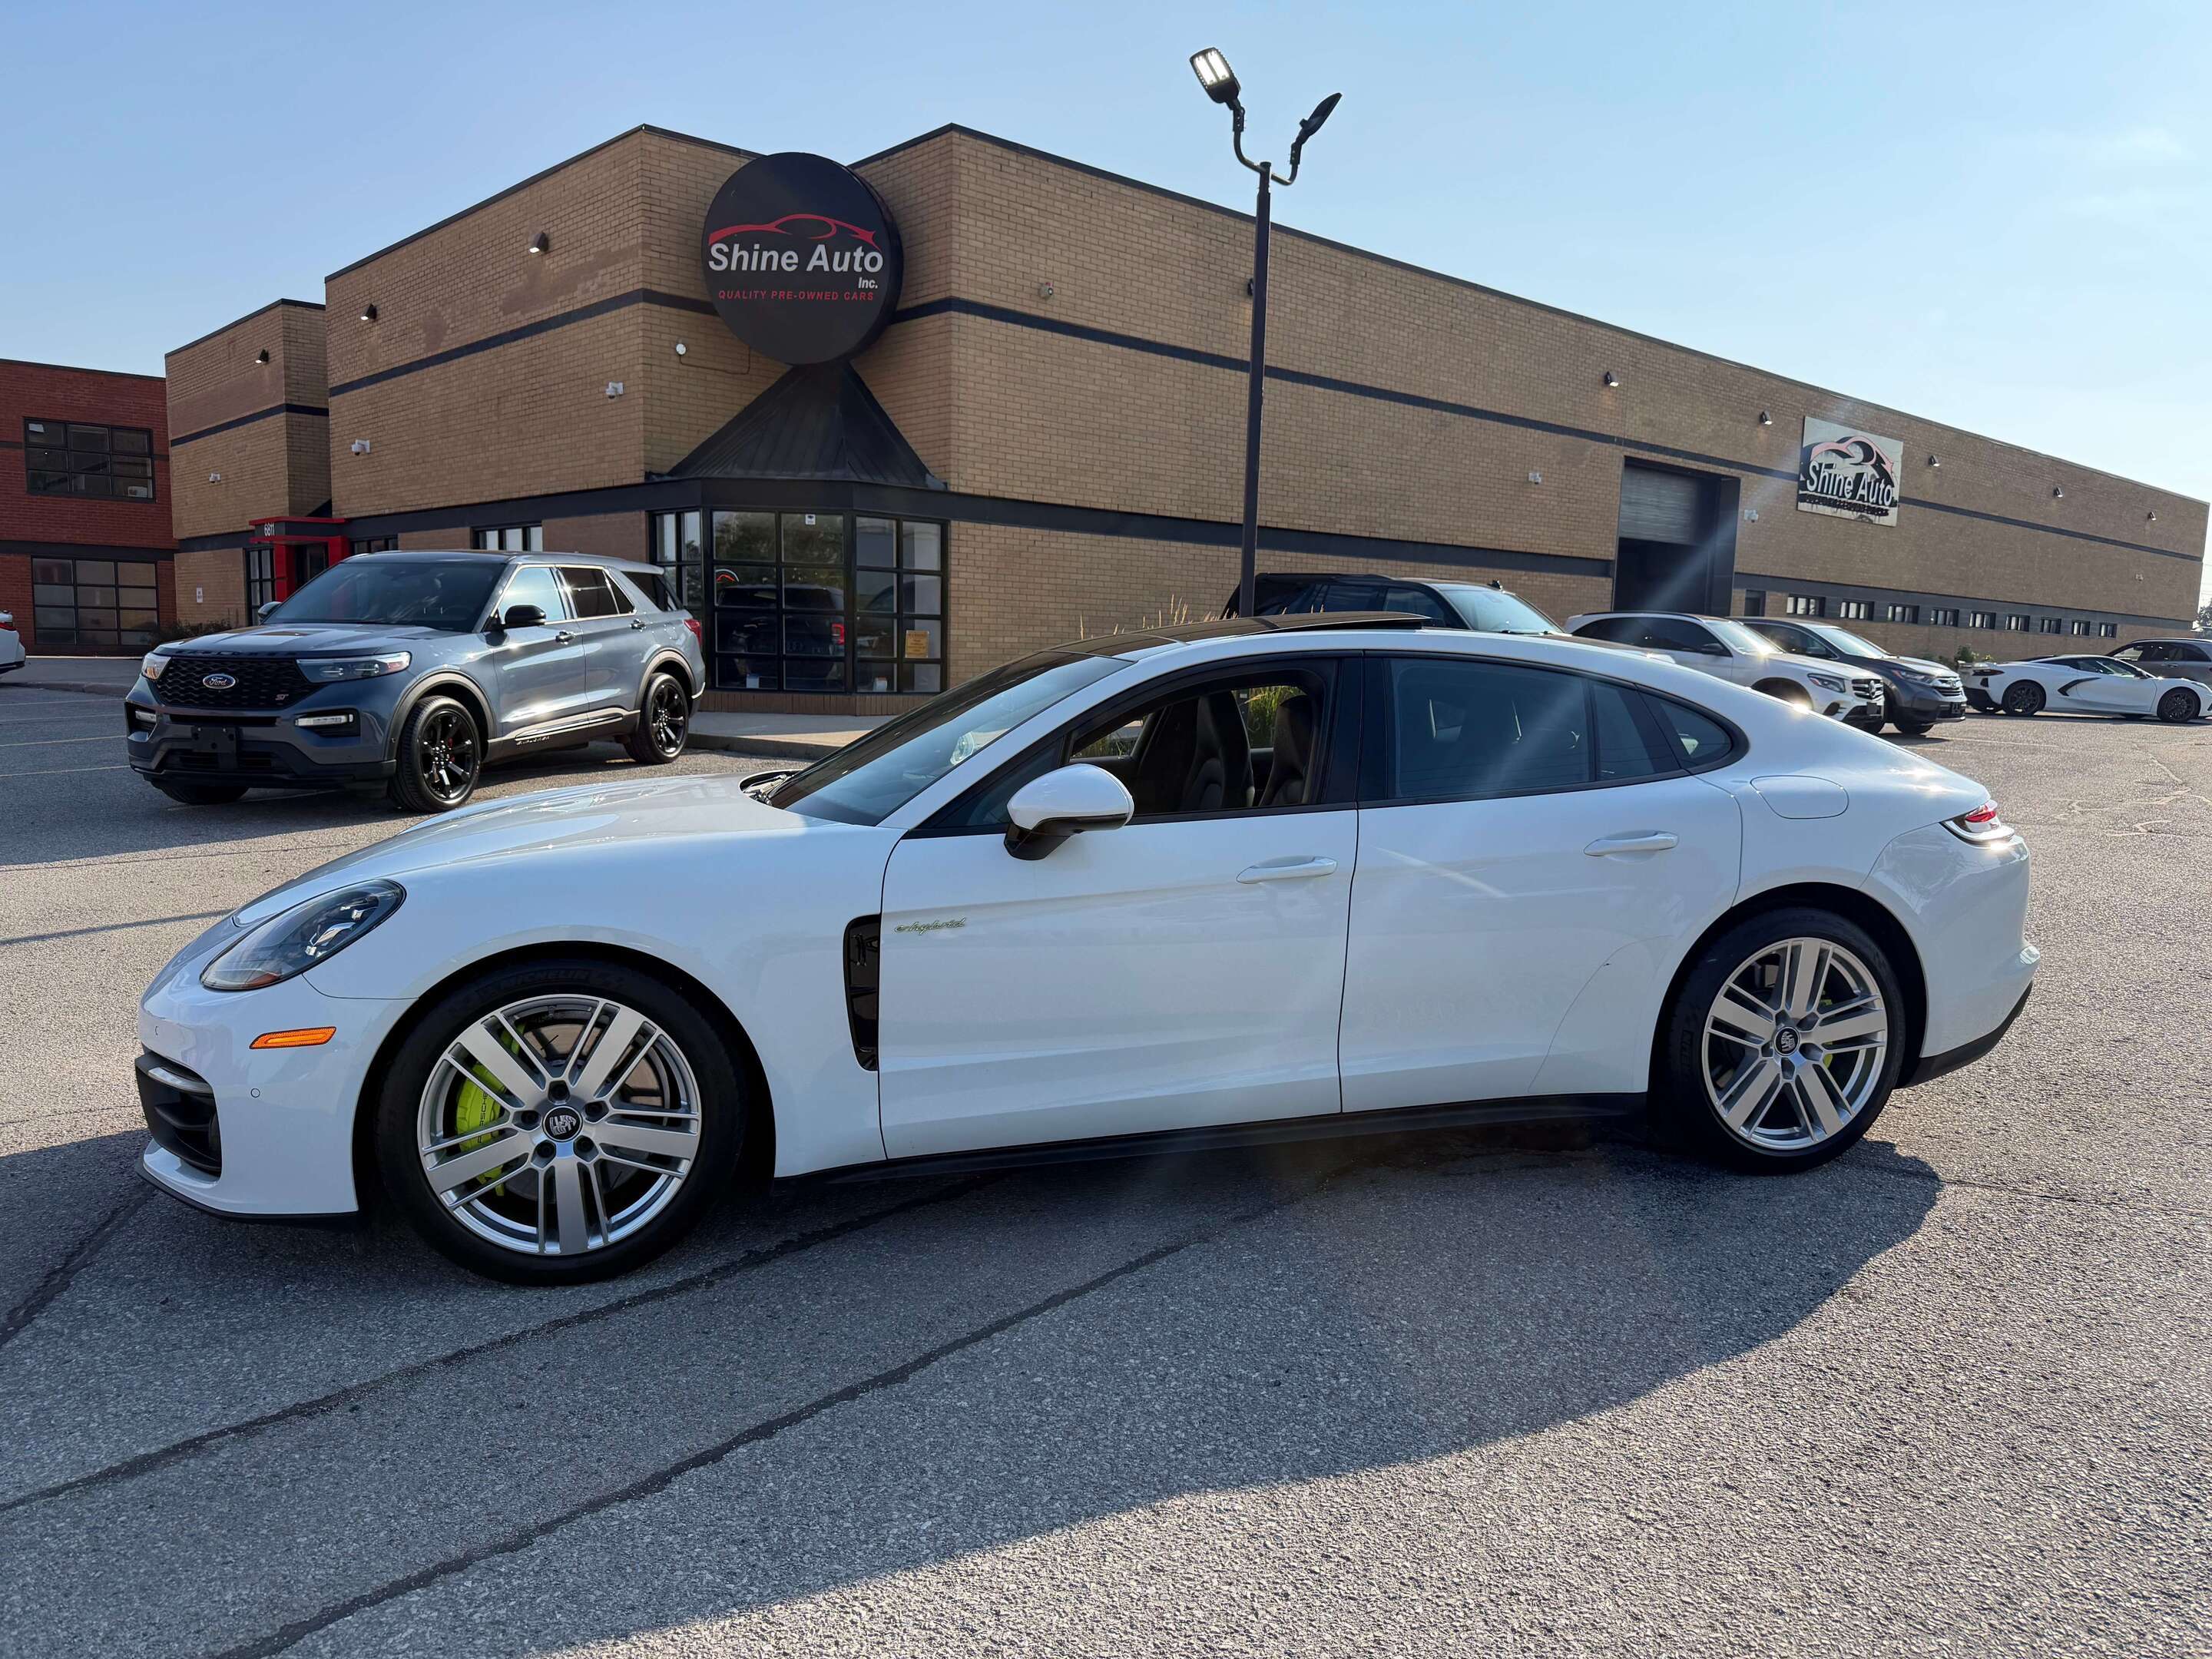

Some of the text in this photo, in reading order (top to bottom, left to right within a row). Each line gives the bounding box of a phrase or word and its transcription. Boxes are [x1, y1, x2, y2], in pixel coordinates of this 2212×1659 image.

[709, 243, 883, 273] Shine Auto
[858, 277, 878, 289] Inc.
[718, 290, 874, 301] QUALITY PRE-OWNED CARS
[1806, 461, 1853, 499] Shine
[1856, 472, 1893, 506] Auto
[264, 522, 275, 536] 6811
[207, 675, 227, 686] Ford
[477, 1091, 488, 1144] PRSCHE
